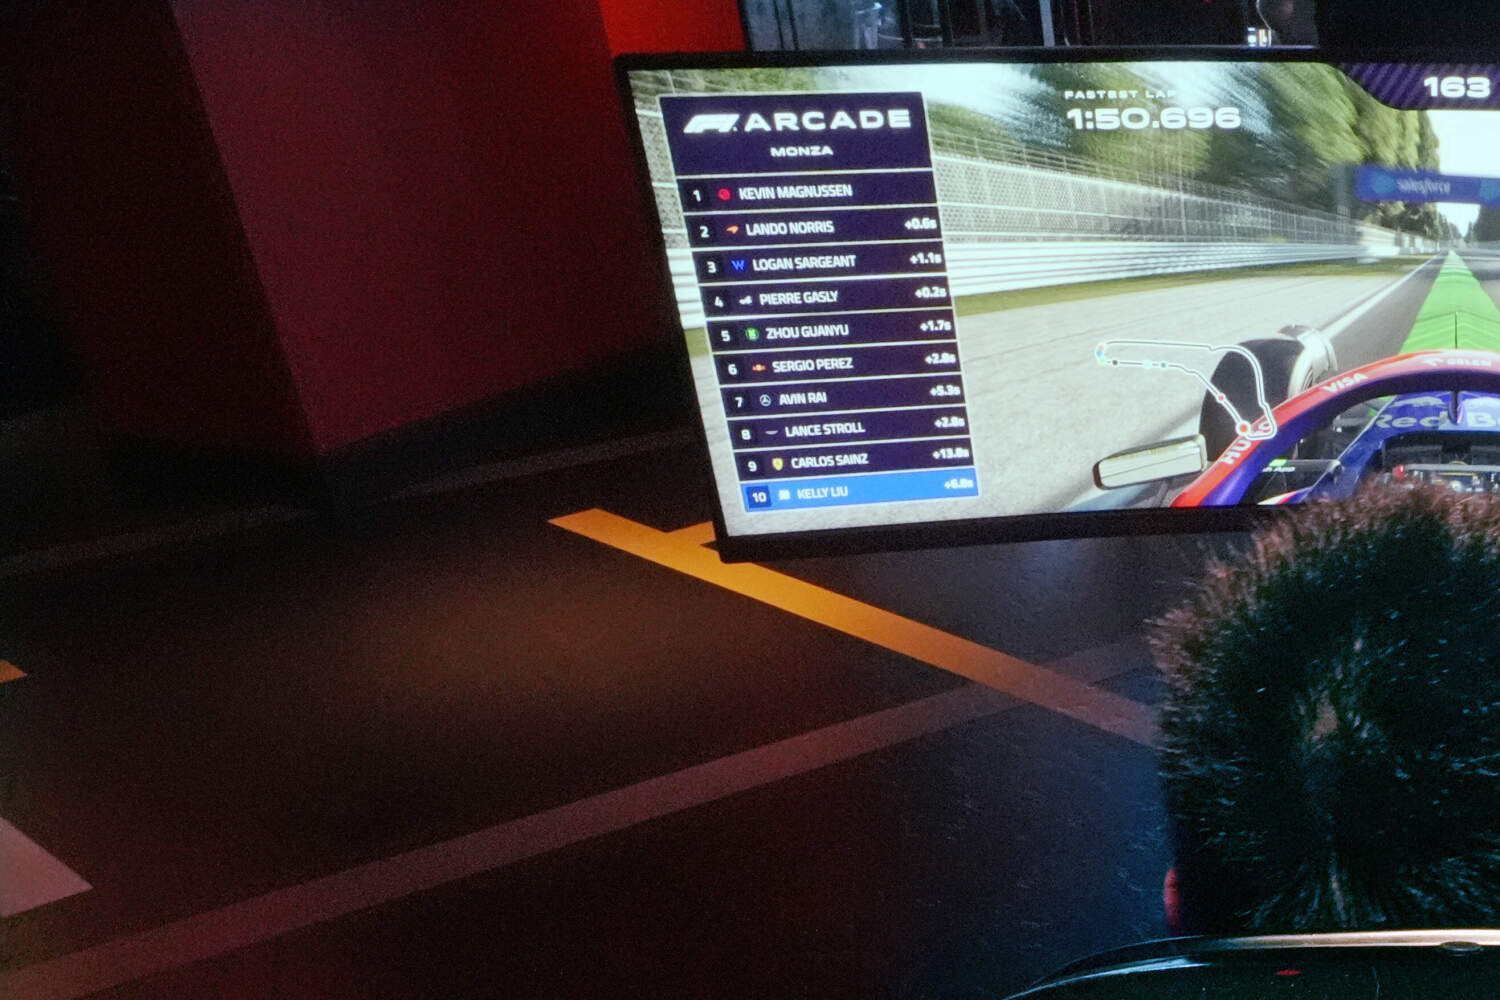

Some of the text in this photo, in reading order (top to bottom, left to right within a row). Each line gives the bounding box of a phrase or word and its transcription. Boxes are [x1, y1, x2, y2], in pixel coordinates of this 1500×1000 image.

[1064, 90, 1138, 99] FASTEST
[1423, 76, 1491, 98] 163
[744, 109, 911, 132] ARCADE
[1066, 107, 1241, 130] 1:50.696
[770, 146, 833, 157] MONZA
[693, 184, 852, 201] 1 KEVIN MAGNUSSEN
[700, 226, 709, 238] 2
[746, 222, 789, 236] LANDO
[791, 221, 835, 234] NORRIS
[708, 262, 716, 273] 3
[753, 257, 793, 271] LOGAN
[794, 255, 857, 269] SARGEANT
[714, 297, 723, 308] 4
[759, 292, 800, 305] PIERRE
[803, 290, 838, 303] GASLY
[721, 331, 730, 341] 5
[766, 327, 800, 339] ZHOU
[801, 324, 849, 337] GUANYU
[728, 364, 737, 375] 6
[772, 360, 815, 373] SERGIO
[816, 357, 853, 370] PEREZ
[1323, 373, 1368, 393] VISA
[735, 397, 743, 408] 7
[779, 394, 806, 405] AVIN
[808, 392, 827, 403] RAI
[1375, 411, 1449, 429] Red
[741, 429, 751, 440] 8
[785, 427, 822, 437] LANCE
[823, 422, 865, 434] STROLL
[748, 462, 757, 472] 9
[791, 456, 834, 469] CARLOS
[835, 453, 868, 466] SAINZ
[752, 492, 767, 503] 10
[797, 489, 829, 499] KELLY
[830, 486, 848, 498] LIU
